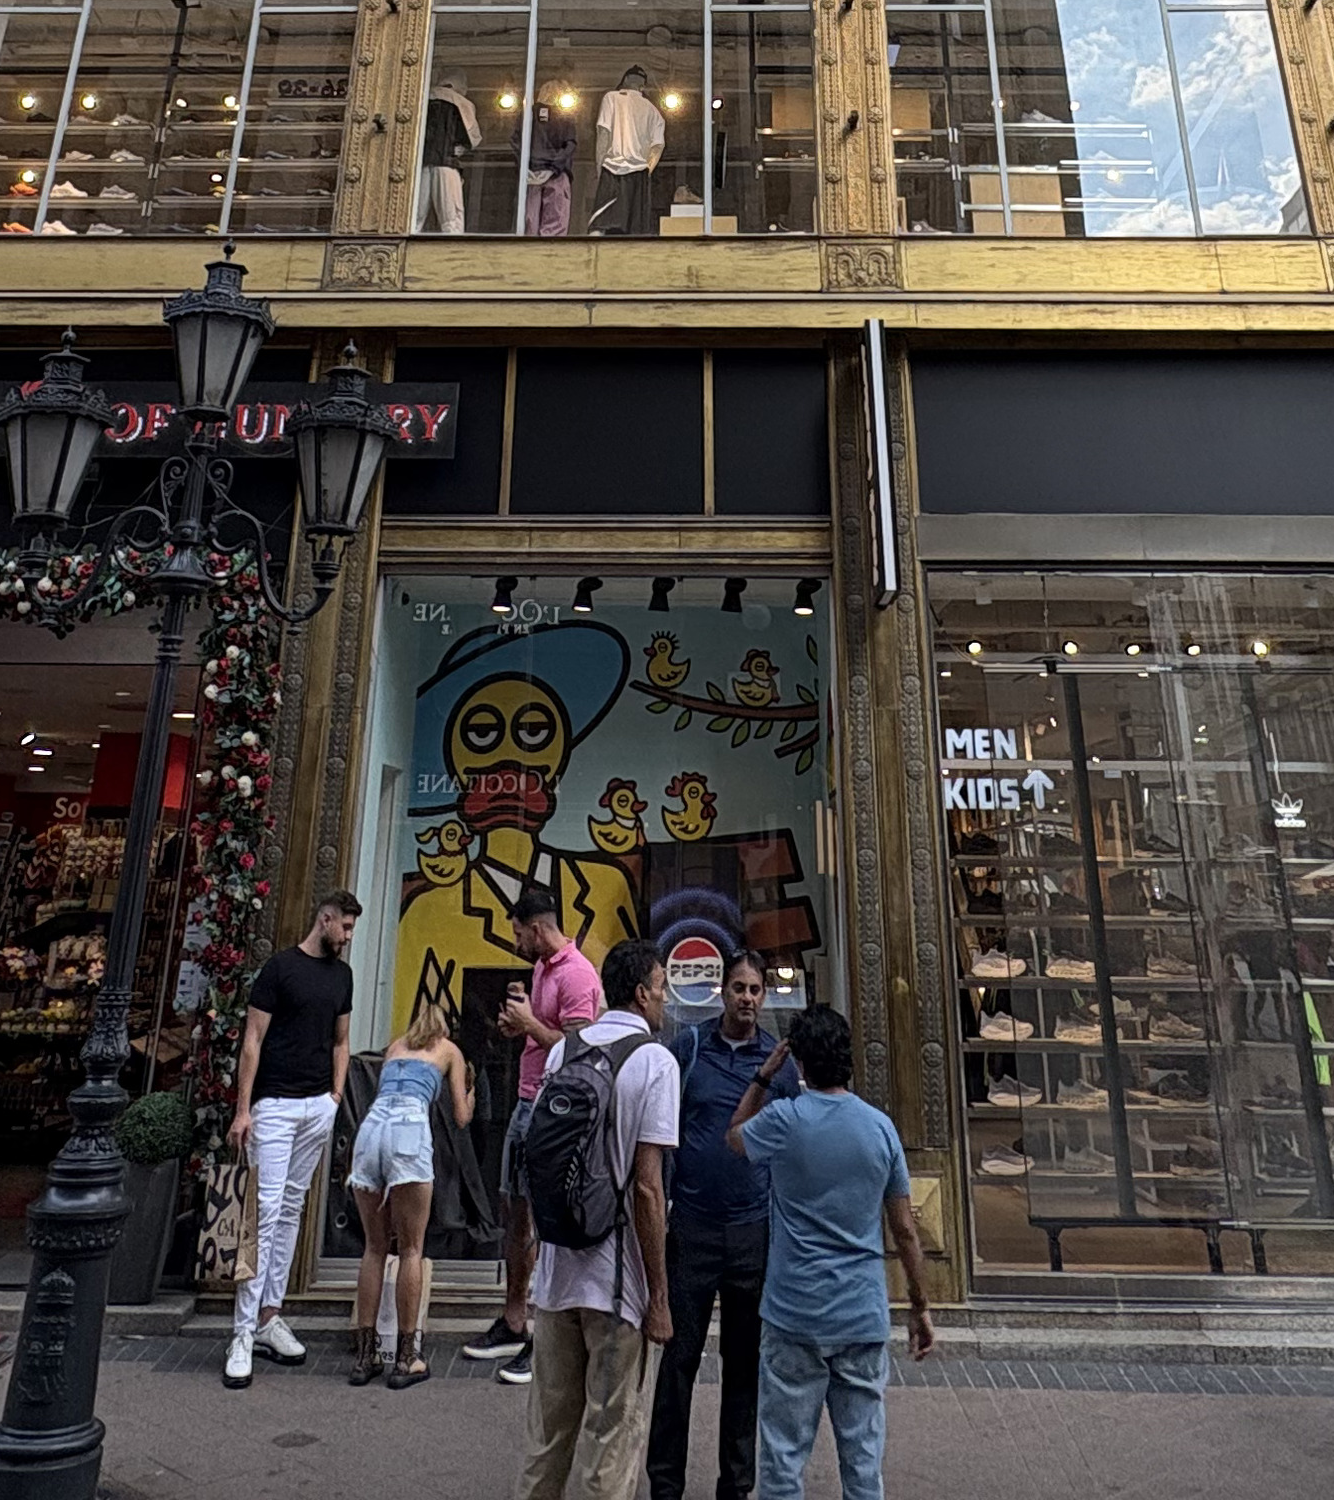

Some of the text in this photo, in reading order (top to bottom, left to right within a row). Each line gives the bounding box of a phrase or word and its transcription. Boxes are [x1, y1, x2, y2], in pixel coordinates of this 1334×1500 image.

[195, 404, 450, 443] UNRY
[945, 728, 1017, 759] MEN
[944, 777, 1020, 810] KIDS
[669, 963, 720, 978] PEPSI
